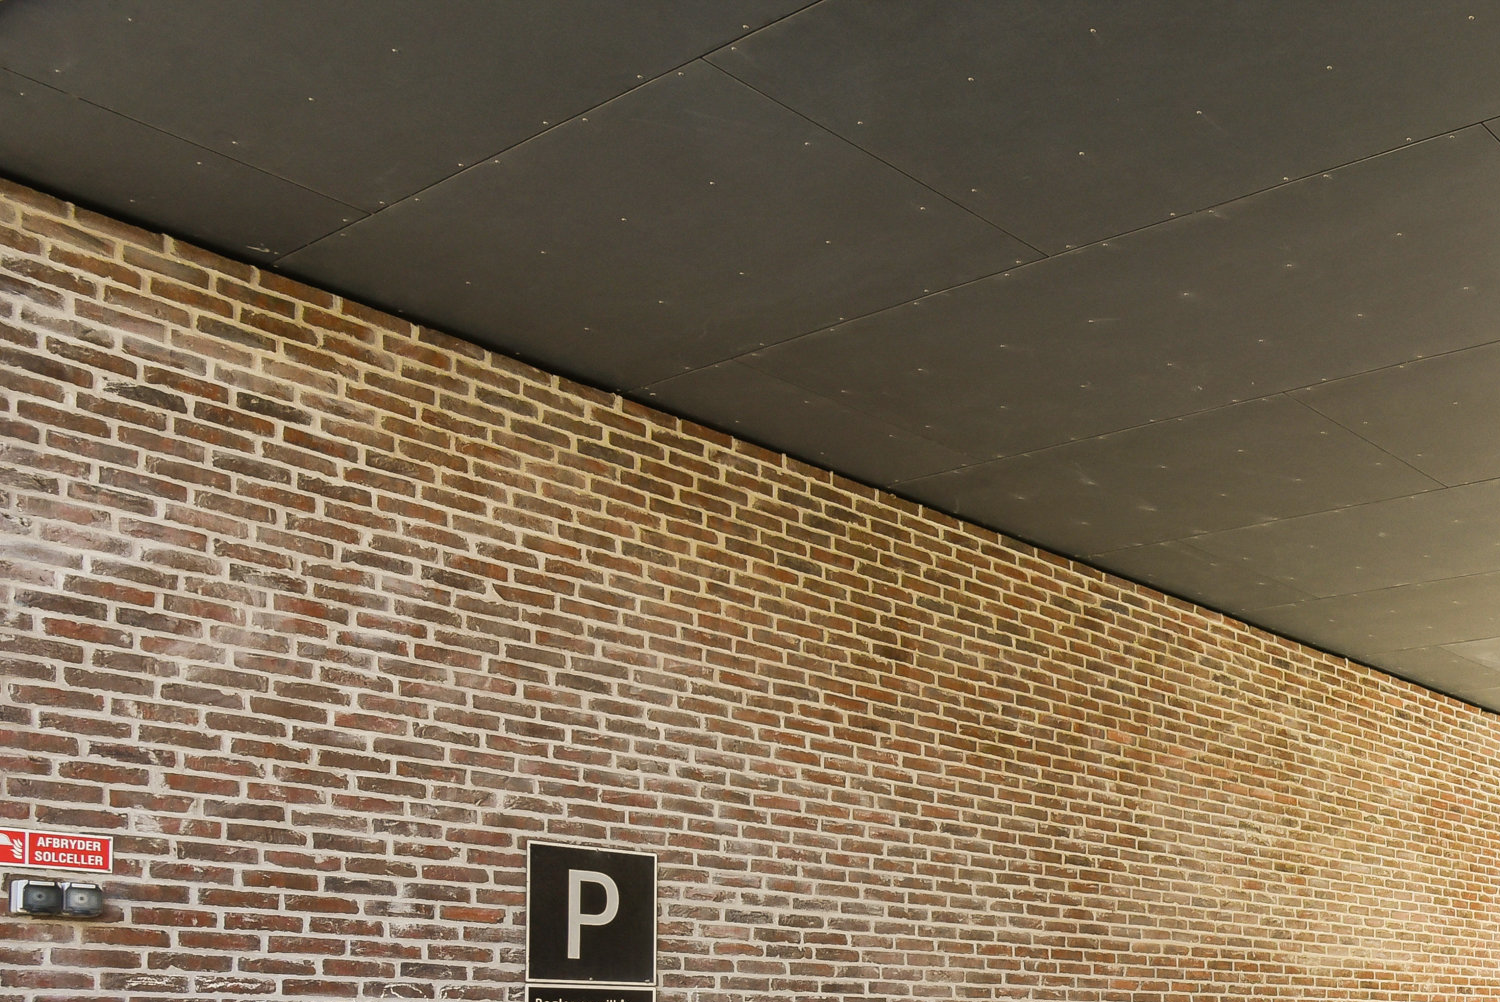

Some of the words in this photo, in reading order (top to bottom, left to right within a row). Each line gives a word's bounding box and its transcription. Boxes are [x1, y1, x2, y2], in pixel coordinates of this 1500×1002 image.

[37, 836, 101, 852] AFBRYDER
[34, 850, 103, 866] SOLCELLER
[567, 868, 620, 960] P
